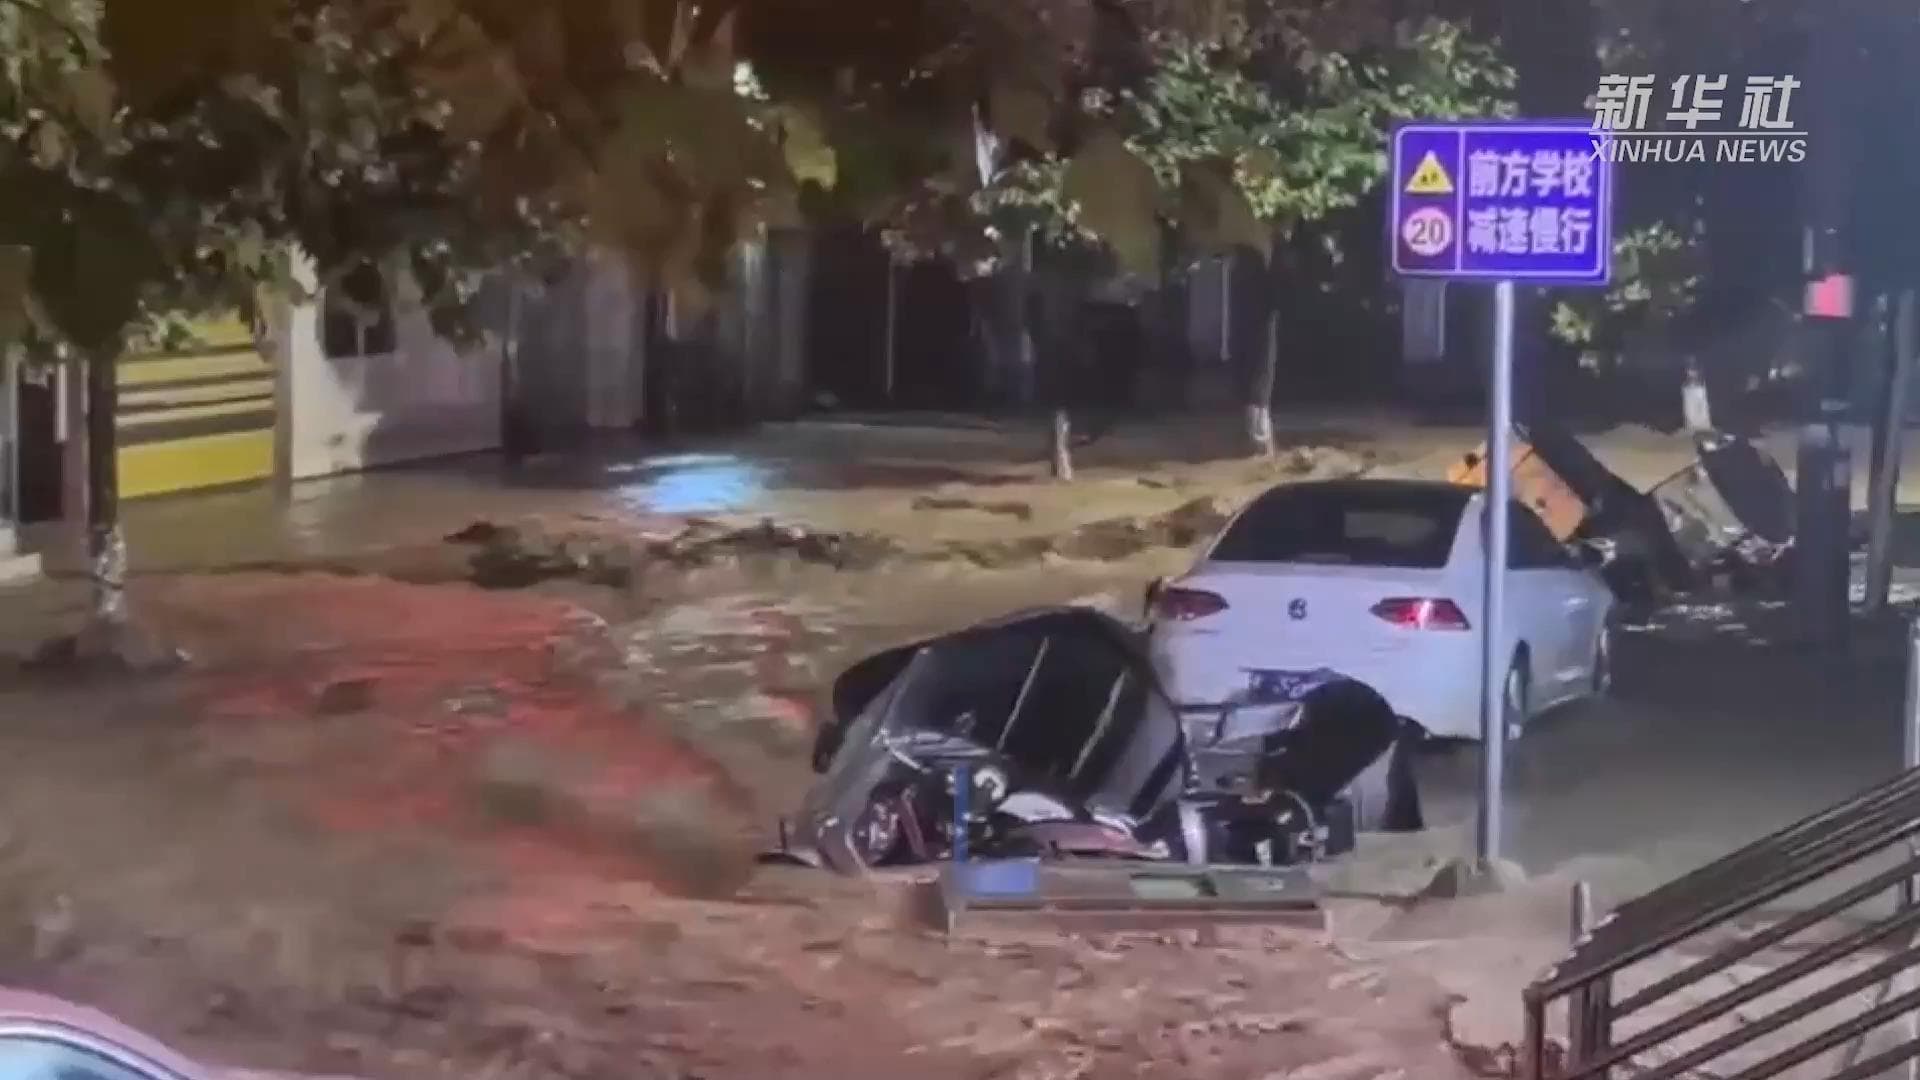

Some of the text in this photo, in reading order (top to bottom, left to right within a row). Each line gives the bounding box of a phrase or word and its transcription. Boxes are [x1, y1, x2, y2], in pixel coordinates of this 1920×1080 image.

[1468, 149, 1592, 197] 前方学校
[1412, 216, 1445, 246] 20
